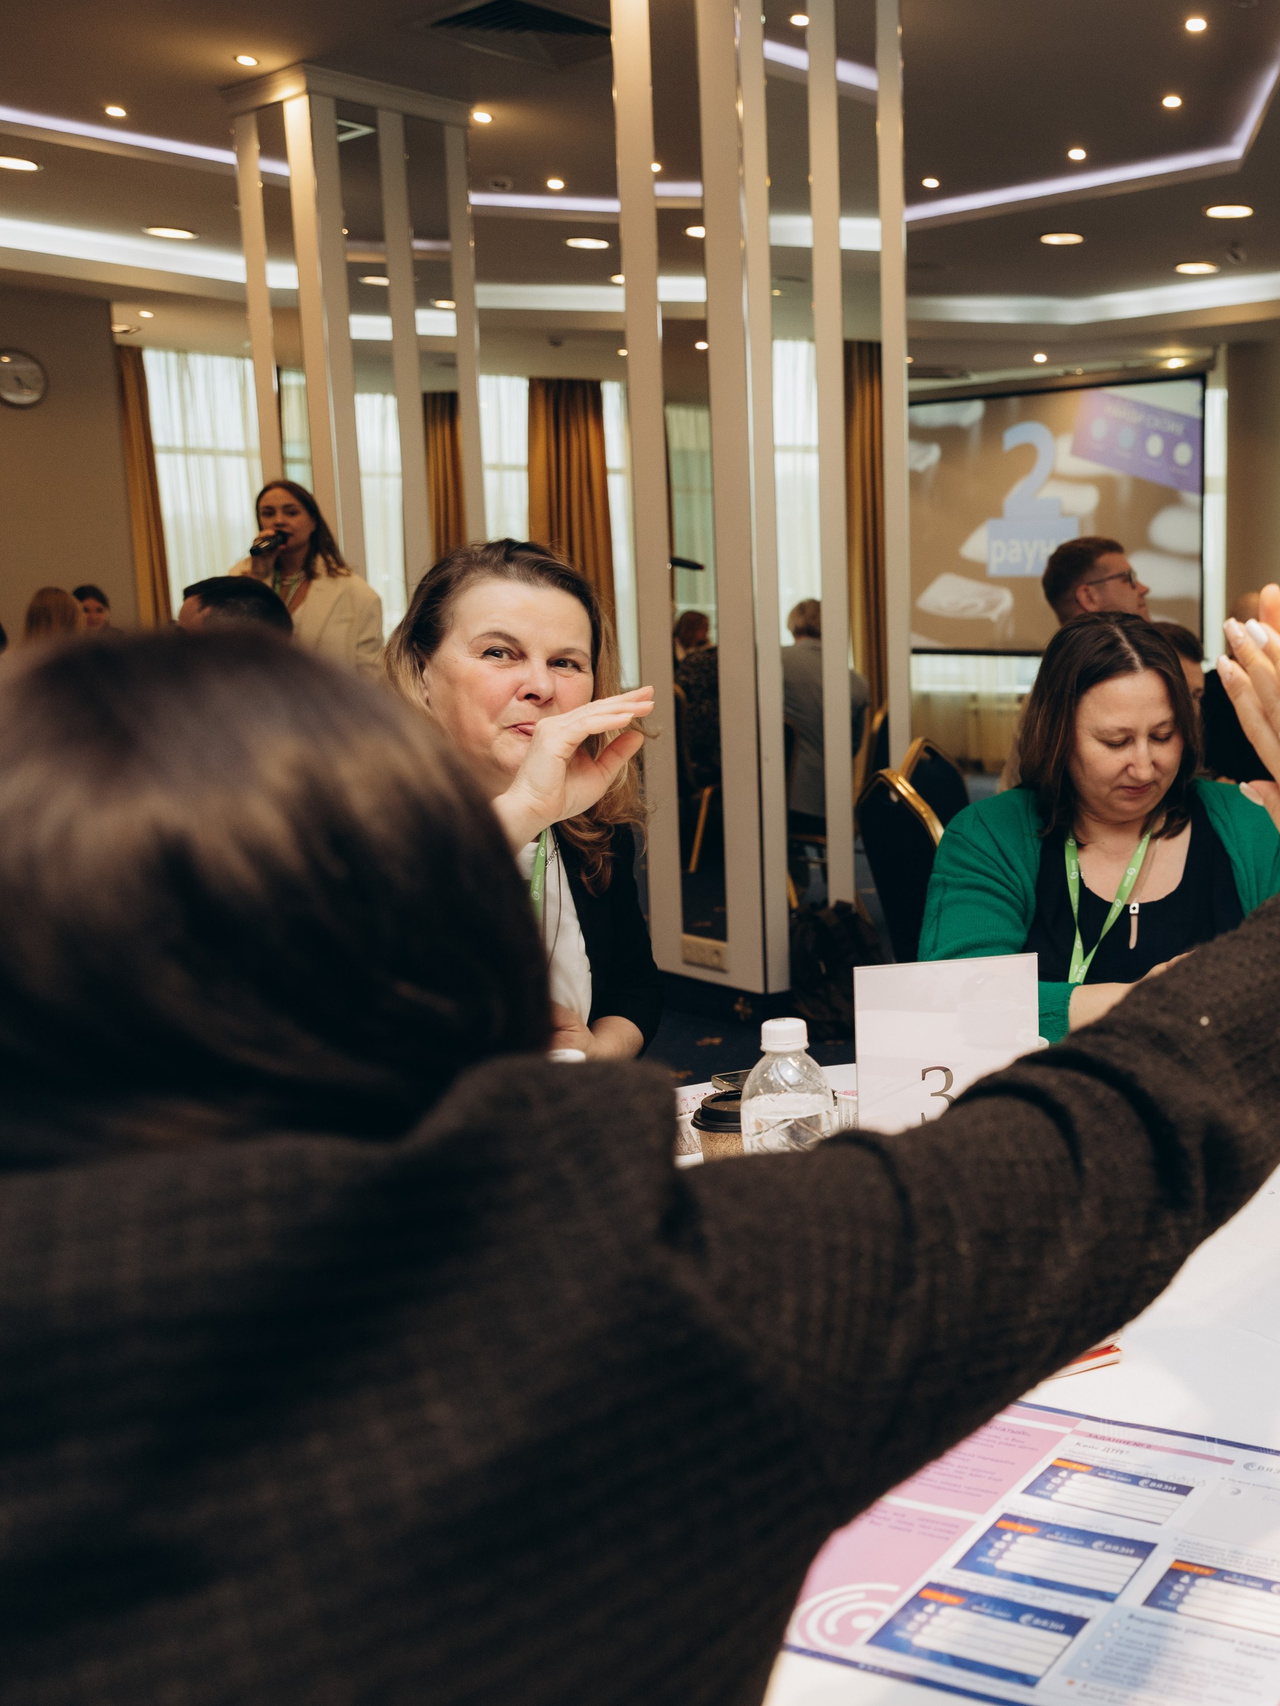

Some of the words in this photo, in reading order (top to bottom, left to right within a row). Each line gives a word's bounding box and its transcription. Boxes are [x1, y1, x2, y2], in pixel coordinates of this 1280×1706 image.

[1002, 420, 1061, 519] 2
[989, 536, 1064, 573] раун
[921, 1066, 956, 1125] 3
[1086, 1433, 1132, 1447] ЗАДАНИЕ
